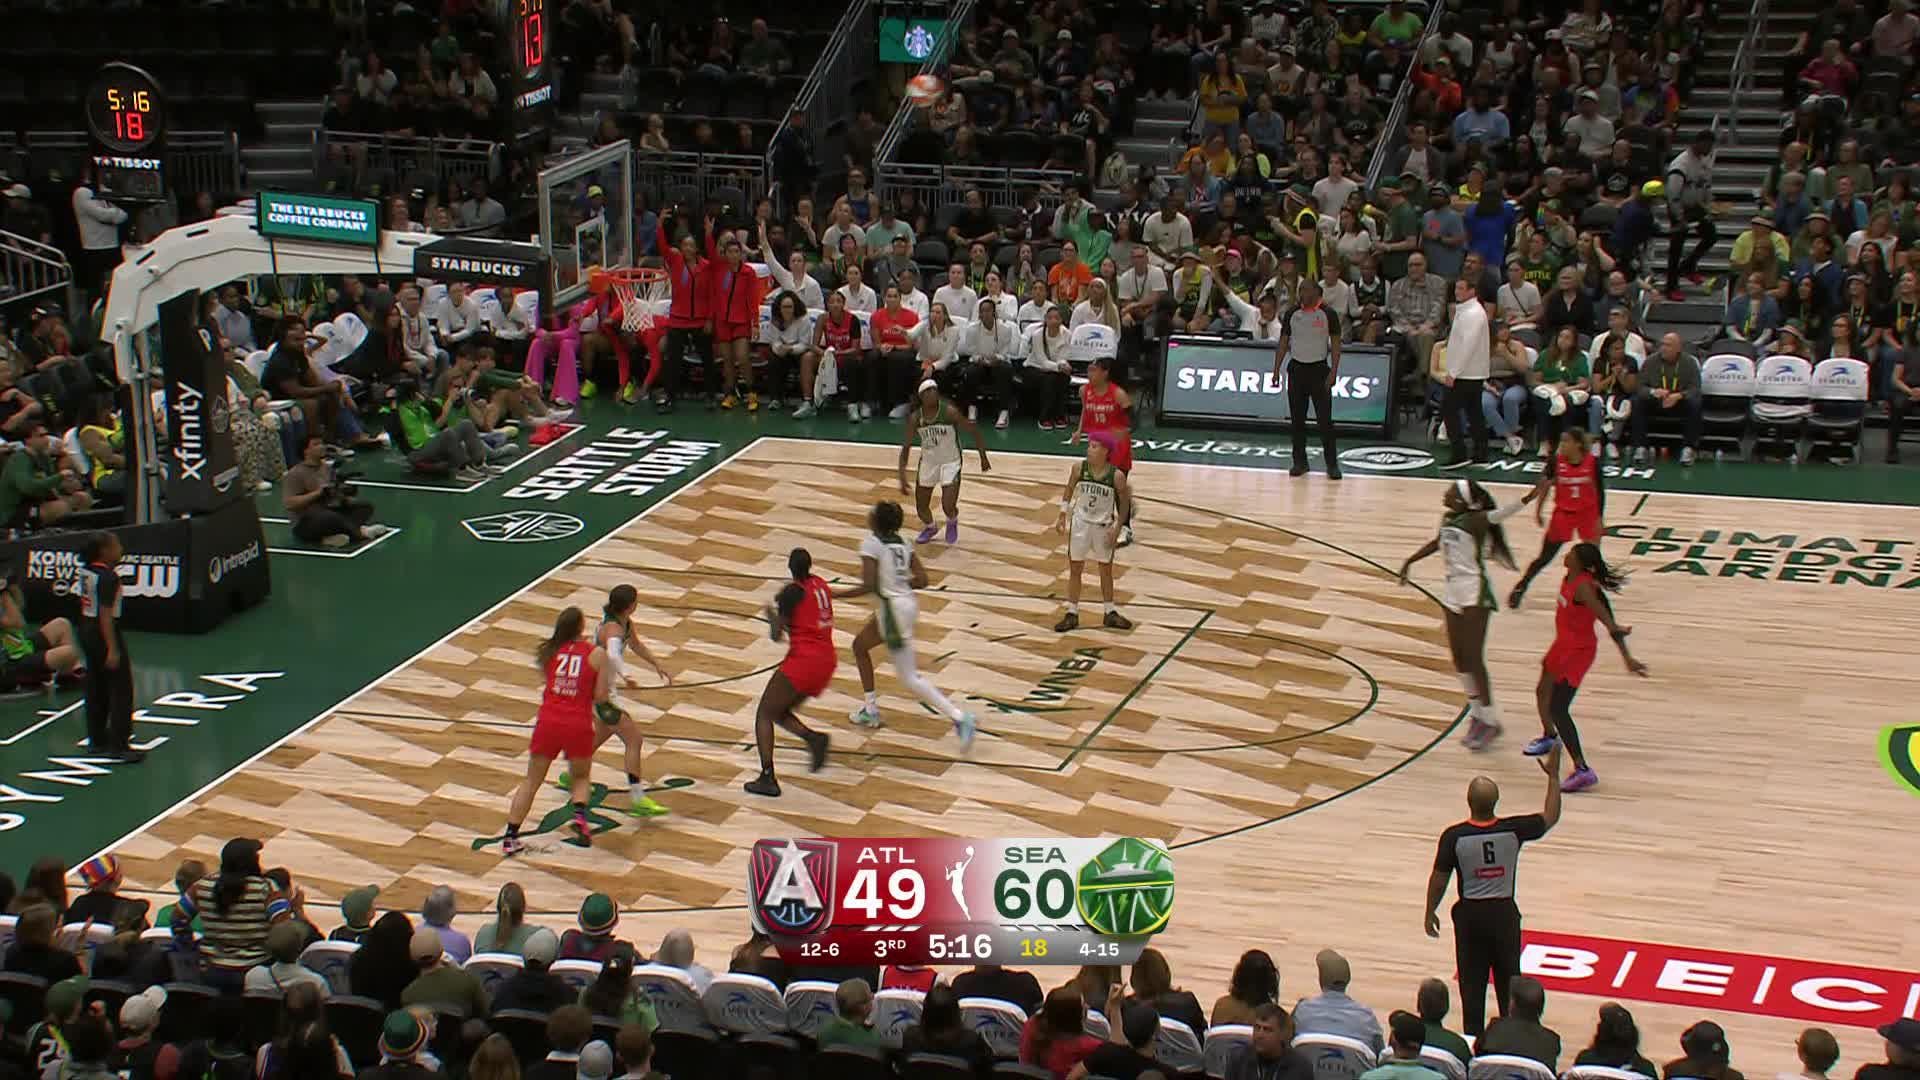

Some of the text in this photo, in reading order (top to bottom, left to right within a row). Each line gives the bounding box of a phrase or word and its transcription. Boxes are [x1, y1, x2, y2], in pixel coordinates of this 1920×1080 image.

[107, 88, 150, 112] 5:16
[115, 111, 144, 140] 18
[112, 157, 161, 169] TISSOT
[267, 213, 369, 231] COFFEE COMPANY
[269, 202, 367, 220] THE STARBUCKS
[430, 256, 522, 277] STARBUCKS
[1177, 367, 1371, 399] STARBKS
[173, 381, 207, 480] xfinity
[503, 427, 669, 500] SEATTLE
[588, 440, 721, 496] STORM
[1080, 484, 1110, 497] STORM
[1601, 524, 1920, 555] CLIMAT
[141, 555, 180, 565] SEATTLE
[1631, 541, 1920, 573] PLEDG
[555, 653, 582, 677] 20
[1483, 841, 1495, 864] 6
